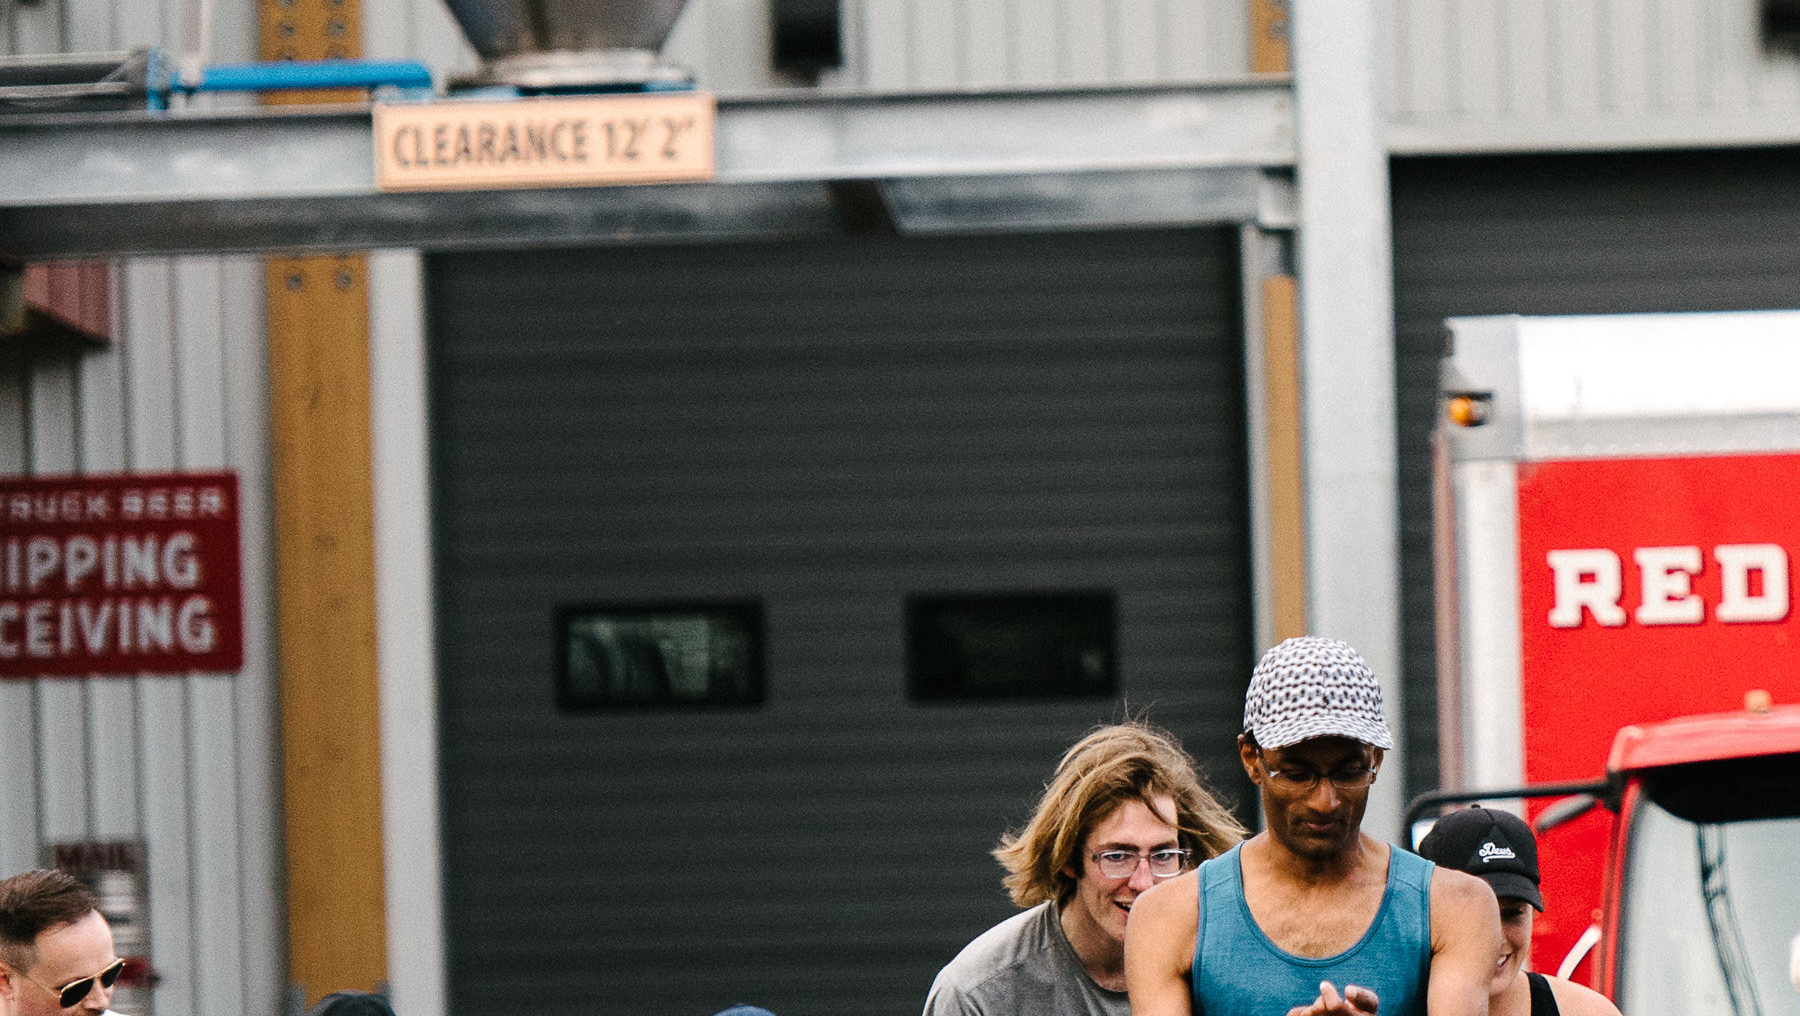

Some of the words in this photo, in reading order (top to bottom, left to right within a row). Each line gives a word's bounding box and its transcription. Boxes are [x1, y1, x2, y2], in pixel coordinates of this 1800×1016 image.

[393, 120, 589, 167] CLEARANCE
[0, 491, 109, 521] RUCK
[0, 530, 201, 590] IPPING
[1546, 544, 1790, 628] RED
